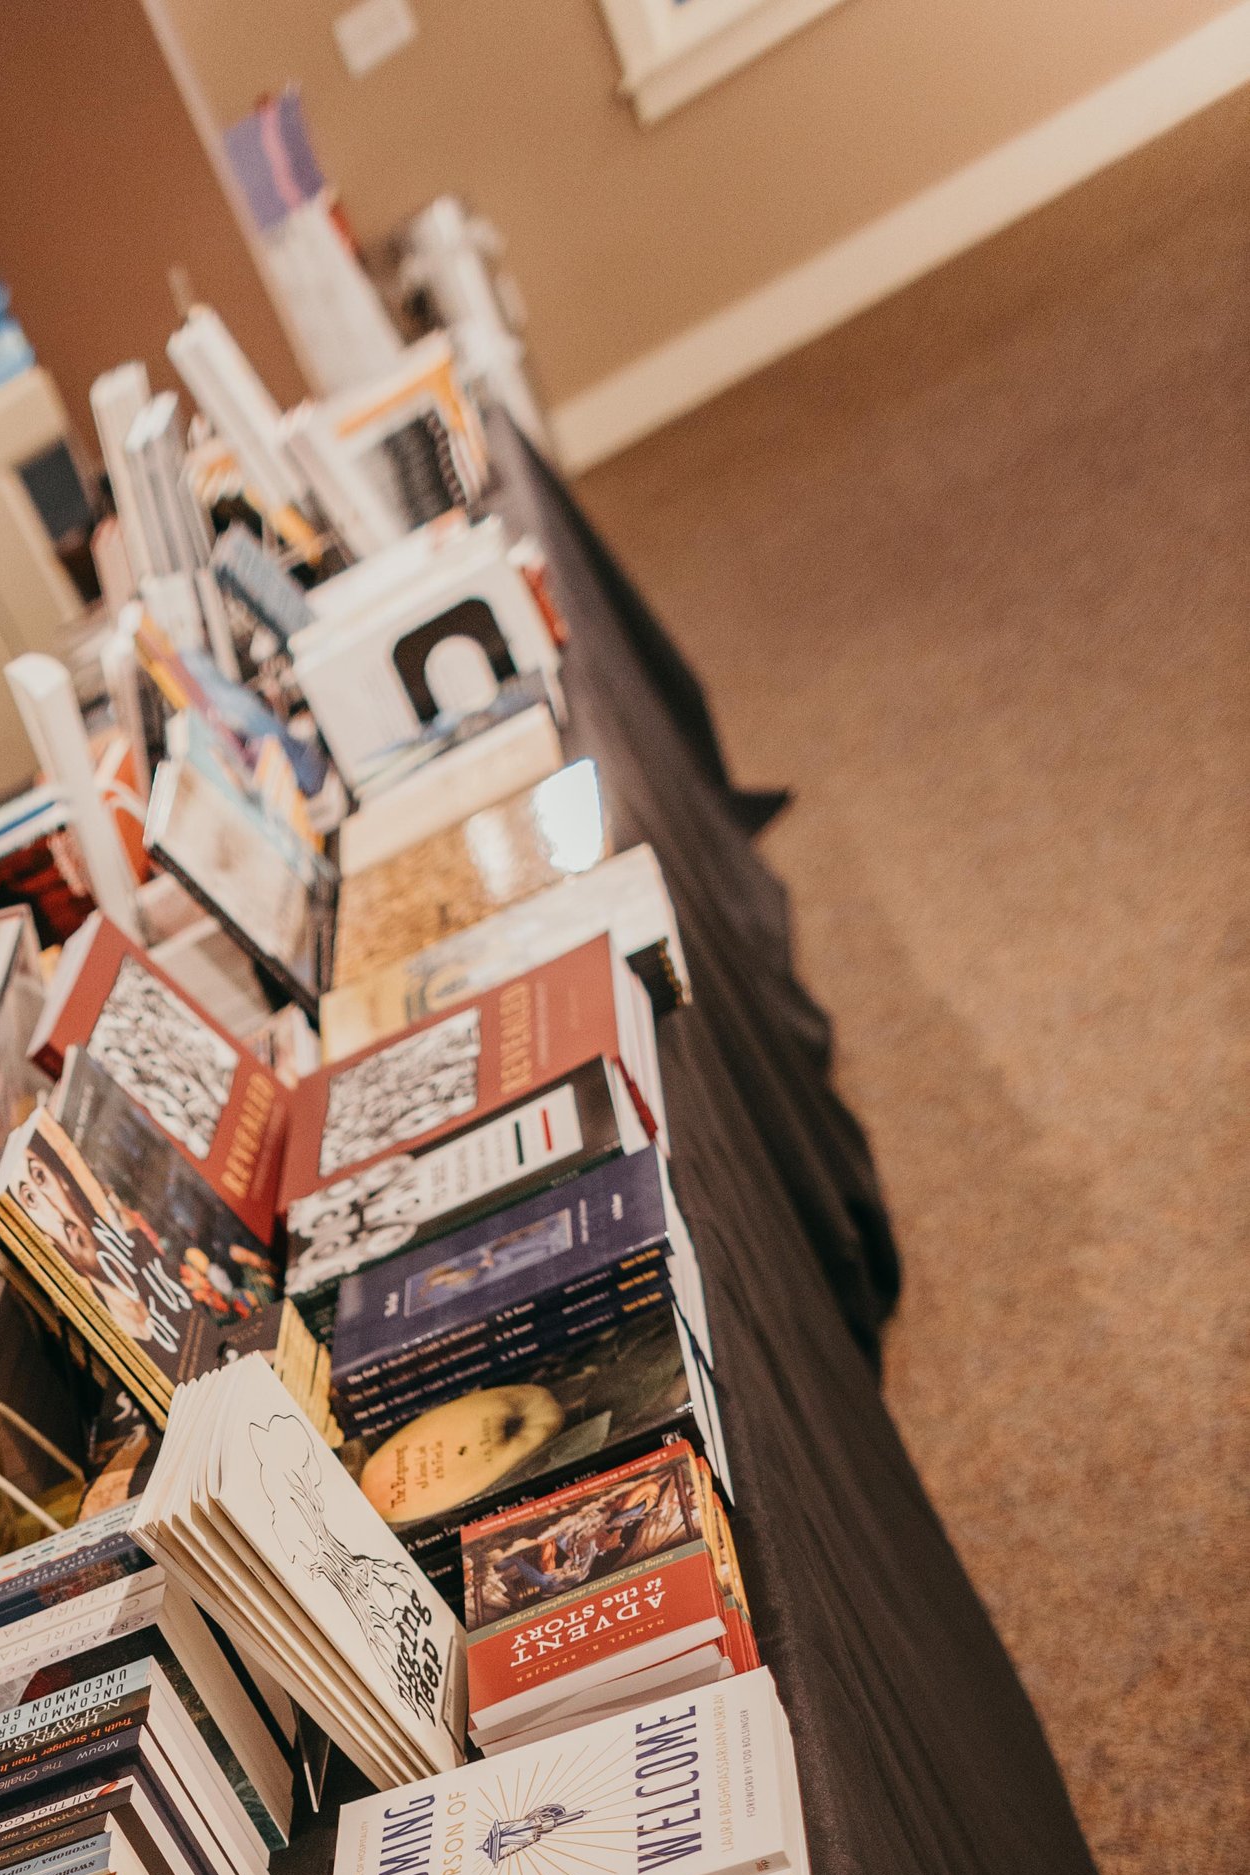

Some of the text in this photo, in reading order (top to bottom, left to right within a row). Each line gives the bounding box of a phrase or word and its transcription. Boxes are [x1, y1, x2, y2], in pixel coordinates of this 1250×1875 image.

[506, 1576, 664, 1650] is the STORY
[505, 1589, 670, 1667] ADVENT
[514, 1617, 665, 1683] DANIEL R. SPANJER
[29, 1668, 128, 1713] UNCOMMON
[25, 1682, 125, 1728] UNCOMMON
[81, 1697, 122, 1719] NOT
[12, 1714, 100, 1753] HEAVEN IS
[41, 1714, 76, 1734] MY
[89, 1727, 102, 1738] Is
[102, 1716, 133, 1735] Truth
[39, 1732, 88, 1758] Stranger
[74, 1738, 120, 1762] Mouw
[9, 1752, 37, 1769] Than
[39, 1759, 63, 1774] The
[713, 1692, 733, 1853] LAURA BAGHDASSARIAN MURRAY
[740, 1707, 755, 1818] FOREWORD BY TOD BOLSINGER
[68, 1790, 93, 1806] All
[635, 1705, 702, 1874] WELCOME
[28, 1800, 67, 1820] That
[447, 1791, 467, 1815] OF
[24, 1833, 59, 1852] GOD
[58, 1828, 75, 1840] THE
[357, 1820, 369, 1862] HOSPITALITY
[11, 1846, 25, 1857] OF
[38, 1839, 98, 1866] SWOBODA
[356, 1863, 364, 1873] OF
